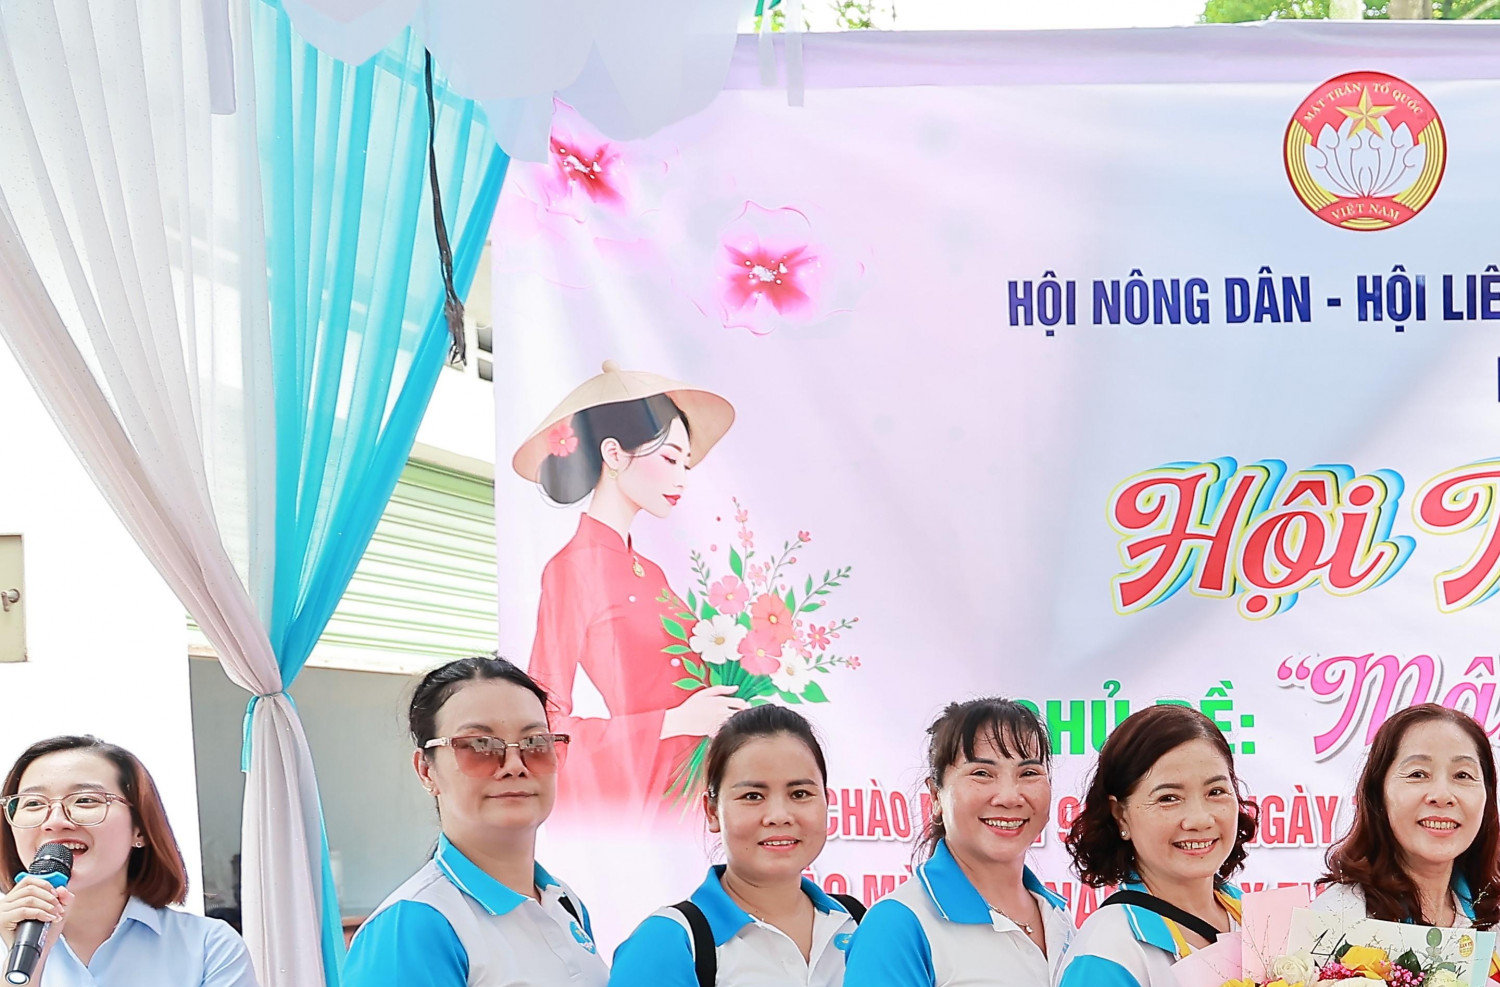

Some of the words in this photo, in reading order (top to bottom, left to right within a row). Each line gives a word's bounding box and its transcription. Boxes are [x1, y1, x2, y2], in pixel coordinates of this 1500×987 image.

[1369, 204, 1400, 221] NAM
[1008, 270, 1076, 337] HỘI
[1092, 268, 1210, 326] NÔNG
[1225, 266, 1312, 324] DÂN
[1357, 264, 1427, 333] HỘI
[1110, 464, 1402, 617] Hội
[1015, 680, 1130, 755] HỦ
